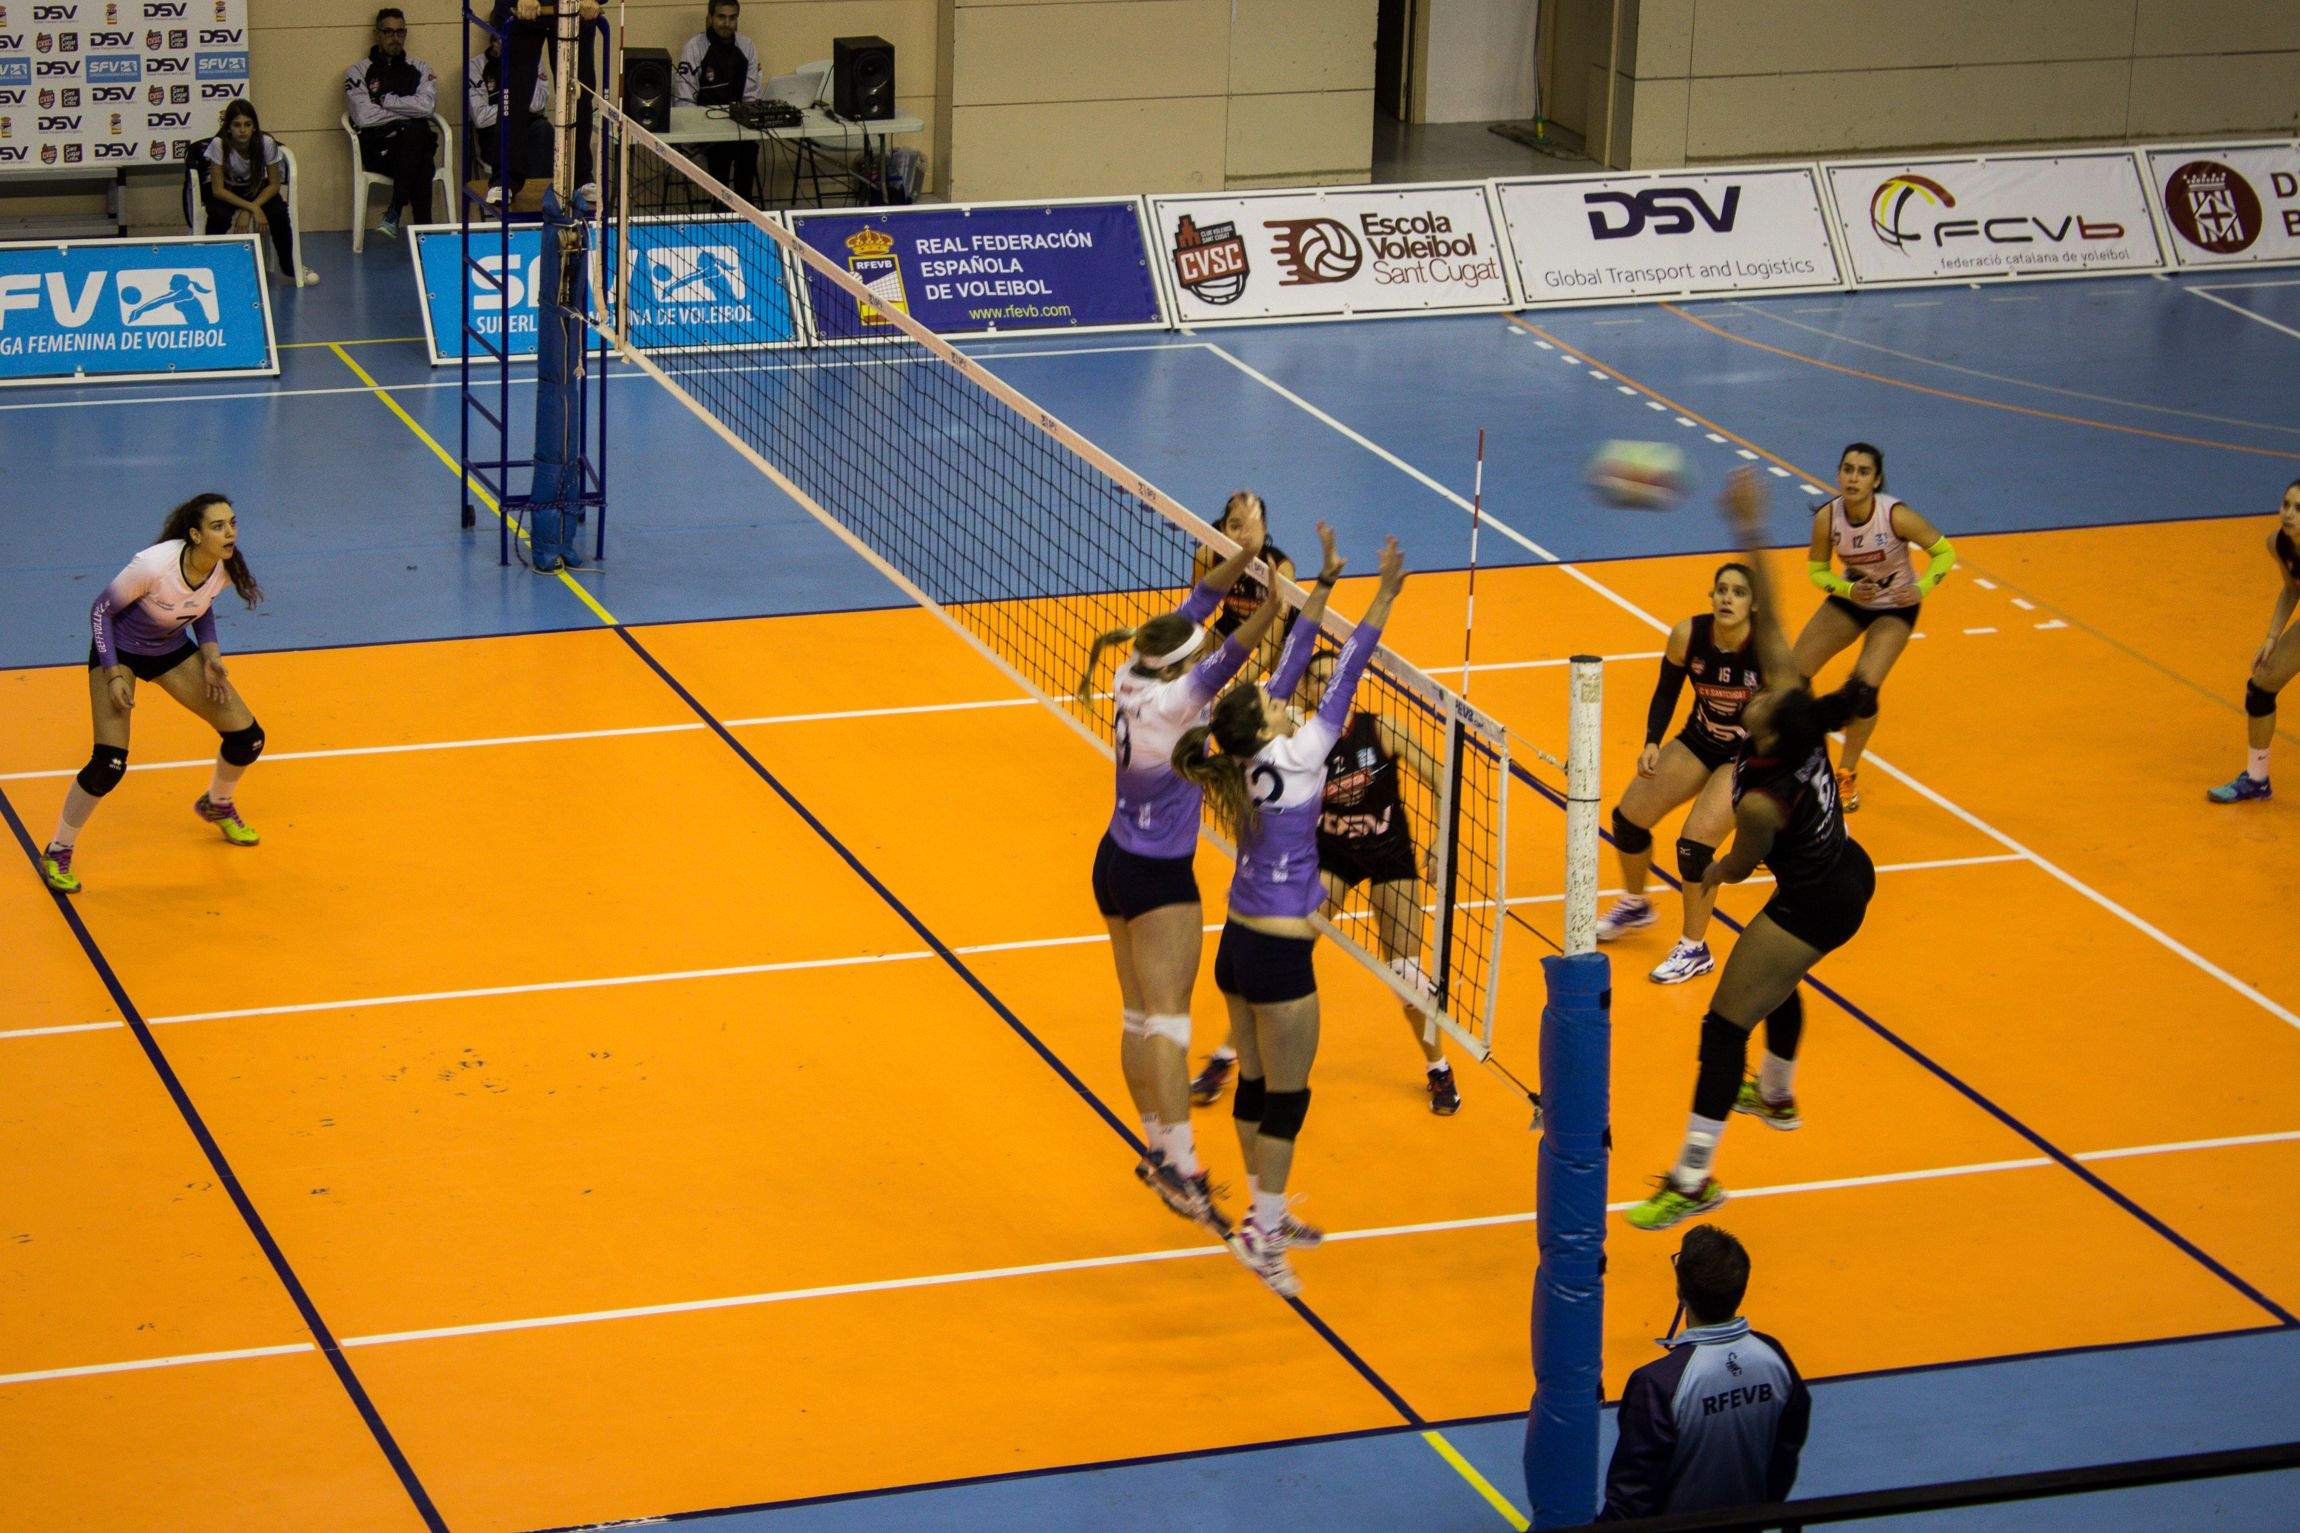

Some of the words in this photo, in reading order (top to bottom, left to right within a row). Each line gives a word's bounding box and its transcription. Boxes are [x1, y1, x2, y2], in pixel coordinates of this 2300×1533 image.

[33, 5, 78, 20] DSV
[144, 2, 187, 17] DSV
[90, 31, 134, 47] DSV
[199, 29, 243, 44] DSV
[36, 60, 81, 76] DSV
[89, 61, 120, 73] SFV
[146, 57, 190, 72] DSV
[200, 58, 229, 70] SFV
[92, 86, 136, 101] DSV
[201, 83, 245, 98] DSV
[38, 115, 83, 130] DSV
[147, 112, 191, 127] DSV
[95, 142, 138, 157] DSV
[1584, 185, 1741, 240] DSV
[1360, 210, 1452, 237] Escola
[916, 237, 969, 255] REAL
[971, 229, 1093, 252] FEDERACIÓN
[1366, 233, 1478, 260] Voleibol
[856, 259, 893, 271] RFEVB
[920, 256, 1024, 278] ESPAÑOLA
[1180, 243, 1243, 280] CVSC
[1940, 253, 2002, 270] federació
[2004, 252, 2060, 267] catalana
[2062, 251, 2078, 263] de
[2080, 248, 2130, 263] voleibol
[1373, 259, 1428, 285] Sant
[1428, 257, 1500, 288] Cugat
[1545, 266, 1603, 288] Global
[1606, 262, 1694, 285] Transport
[1700, 259, 1732, 278] and
[1737, 257, 1815, 280] Logistics
[925, 284, 953, 300] DE
[957, 279, 1053, 299] VOLEIBOL
[657, 308, 676, 326] DE
[679, 304, 755, 325] VOLEIBOL
[968, 304, 1072, 321] www.rfevb.com
[28, 332, 116, 354] FEMENINA
[121, 331, 142, 351] DE
[146, 329, 227, 350] VOLEIBOL
[1852, 535, 1864, 549] 12
[167, 614, 197, 635] 7
[1718, 666, 1731, 683] 16
[1324, 804, 1391, 840] DSV
[1702, 1383, 1773, 1417] RFEVB
